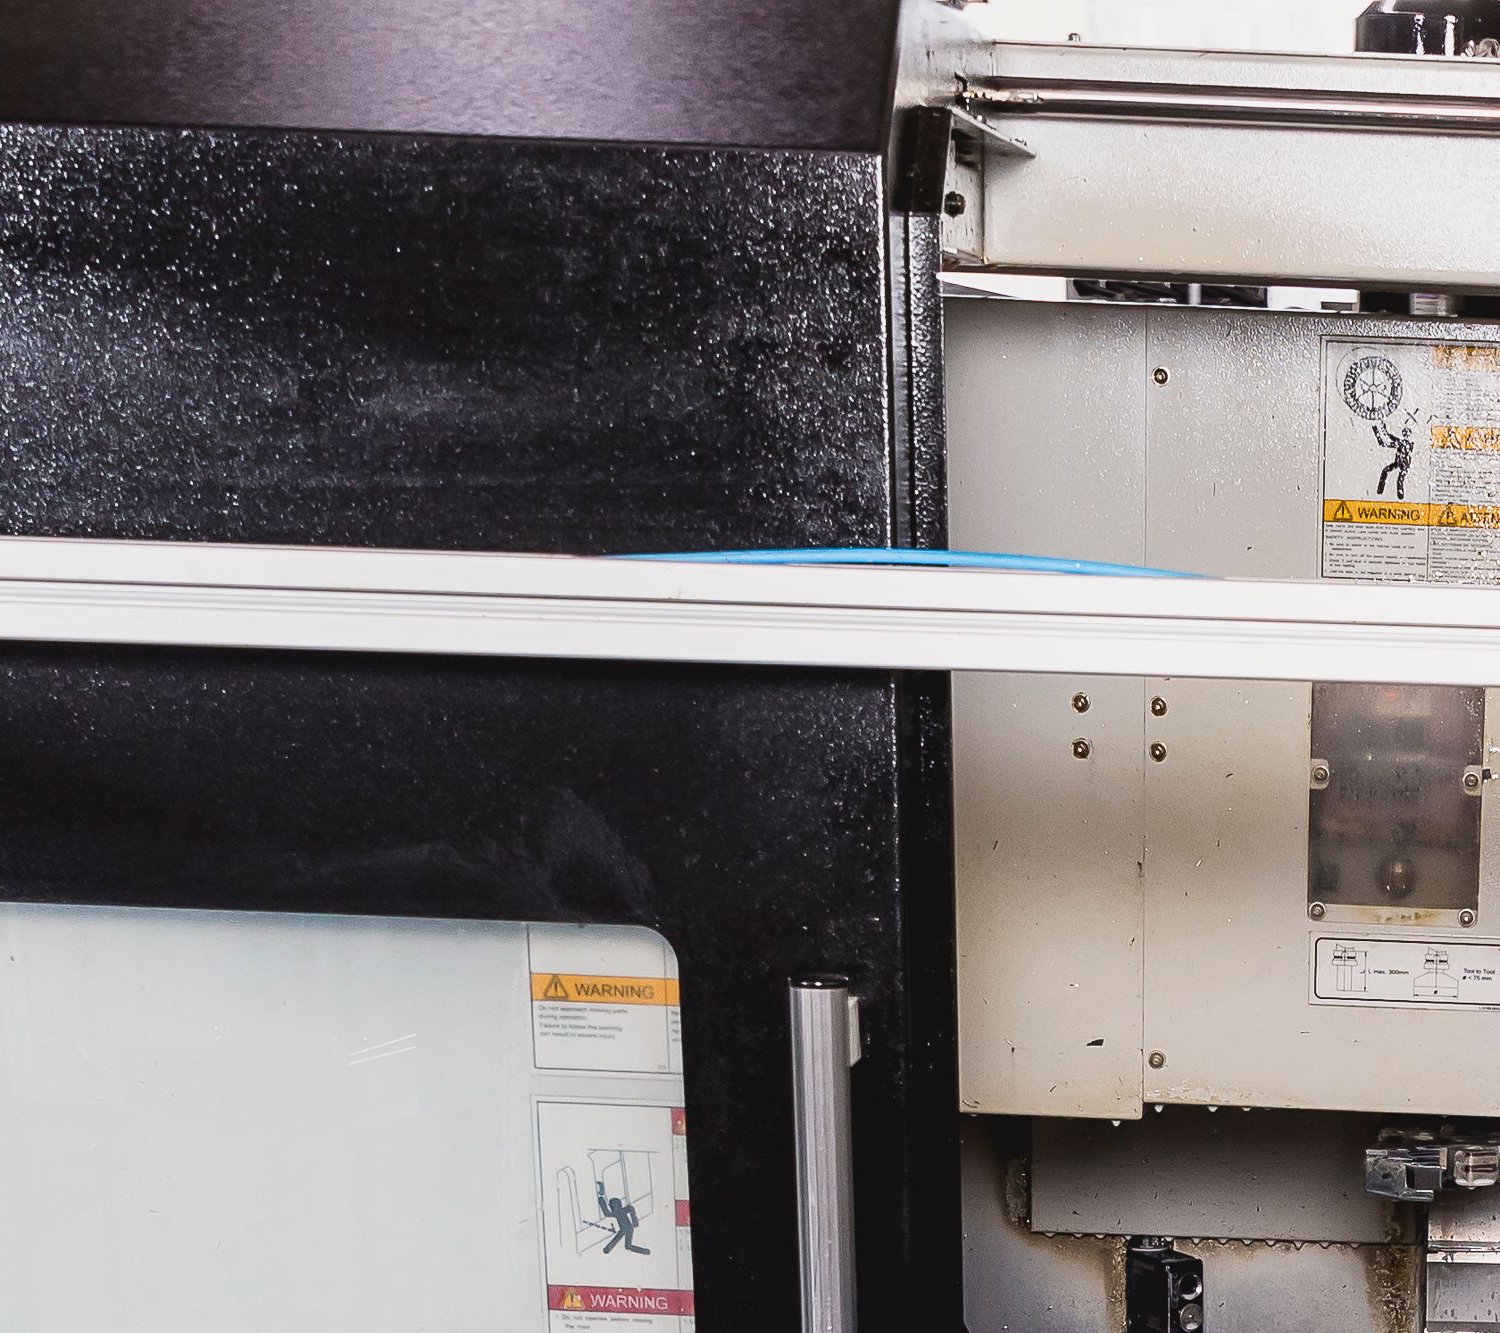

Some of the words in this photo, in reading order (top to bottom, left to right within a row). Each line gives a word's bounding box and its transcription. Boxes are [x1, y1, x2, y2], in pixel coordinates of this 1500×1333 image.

[1358, 508, 1420, 521] WARNING
[575, 983, 654, 999] WARNING
[591, 1293, 668, 1310] WARNING
